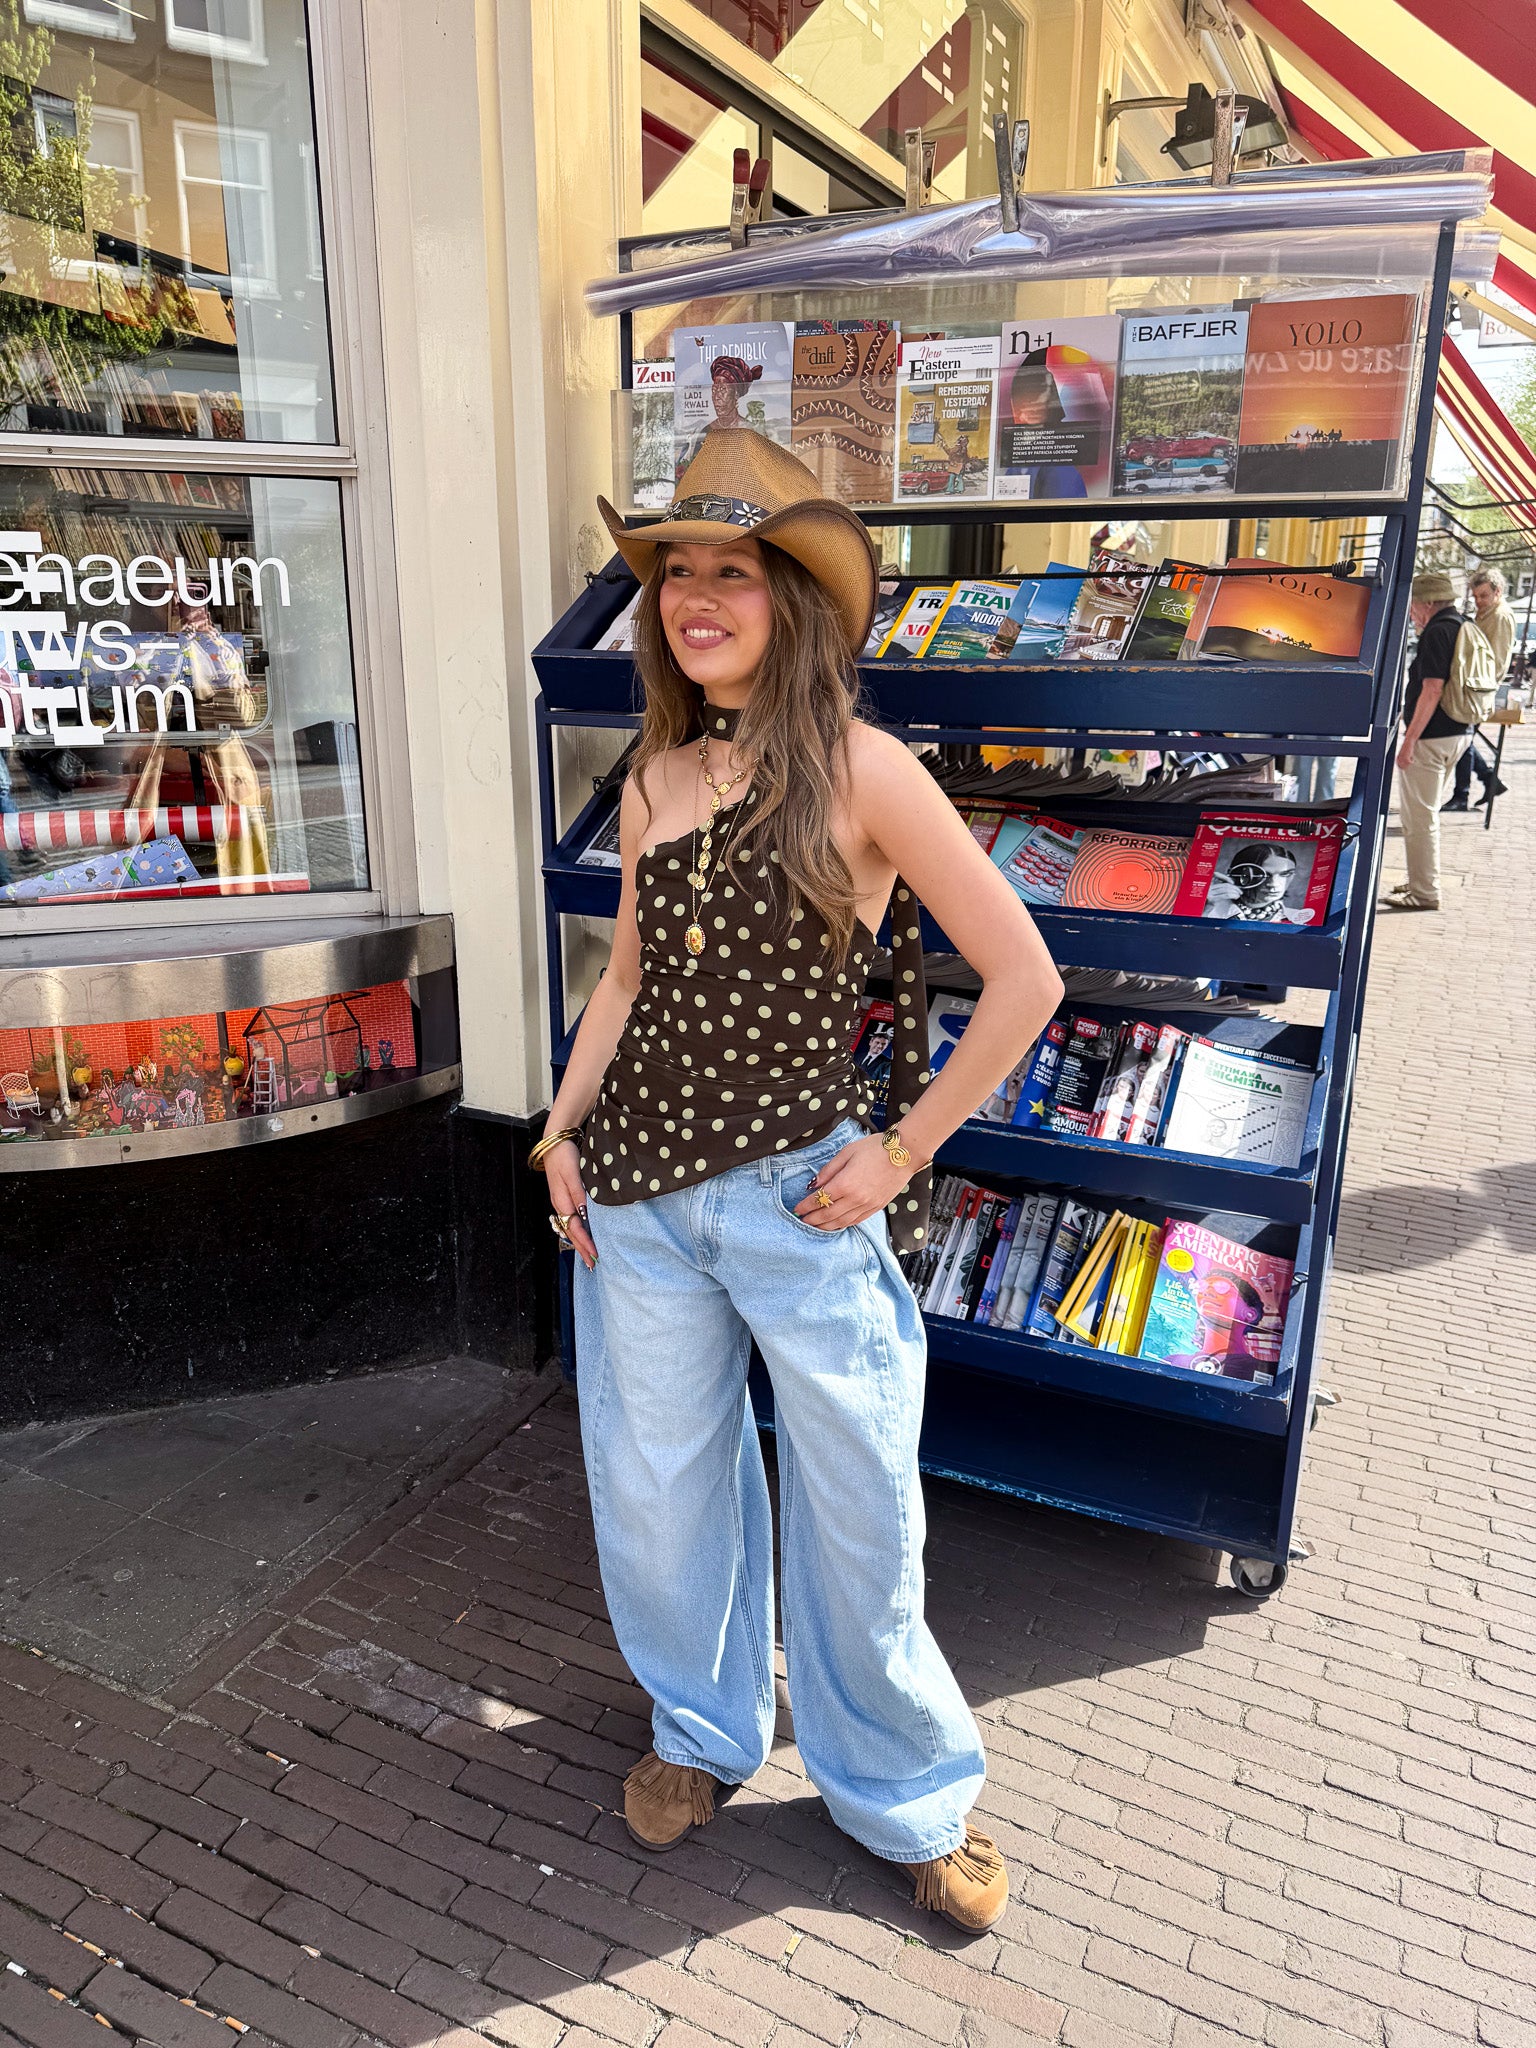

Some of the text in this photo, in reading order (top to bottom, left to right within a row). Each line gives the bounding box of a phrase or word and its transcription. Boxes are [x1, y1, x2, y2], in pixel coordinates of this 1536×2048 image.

[1139, 320, 1238, 342] BAFFLER
[1289, 319, 1363, 347] YOLO
[699, 342, 768, 363] THE REPUBLIC
[801, 344, 812, 355] the
[919, 346, 942, 360] New
[1009, 330, 1053, 355] n+1
[808, 345, 836, 366] drift
[908, 359, 961, 381] Eastern
[684, 391, 703, 400] LADI
[938, 384, 991, 397] REMEMBERING
[684, 400, 710, 410] KWALI
[943, 396, 988, 408] YESTERDAY,
[1208, 817, 1339, 839] Quartely
[1091, 833, 1188, 851] REPORTAGEN
[1076, 1025, 1098, 1037] DE VUE
[1077, 1020, 1100, 1031] POINT
[1039, 1044, 1061, 1068] H
[1214, 1042, 1245, 1055] INVENTAIRE
[1244, 1048, 1263, 1059] AVANT
[1262, 1051, 1296, 1066] SUCCESSION
[1205, 1067, 1283, 1094] ENIGMISTICA
[1051, 1117, 1089, 1133] AMOUR
[1174, 1221, 1261, 1265] SCIENTIFIC
[1170, 1236, 1260, 1276] AMERICAN
[1165, 1278, 1184, 1290] Life
